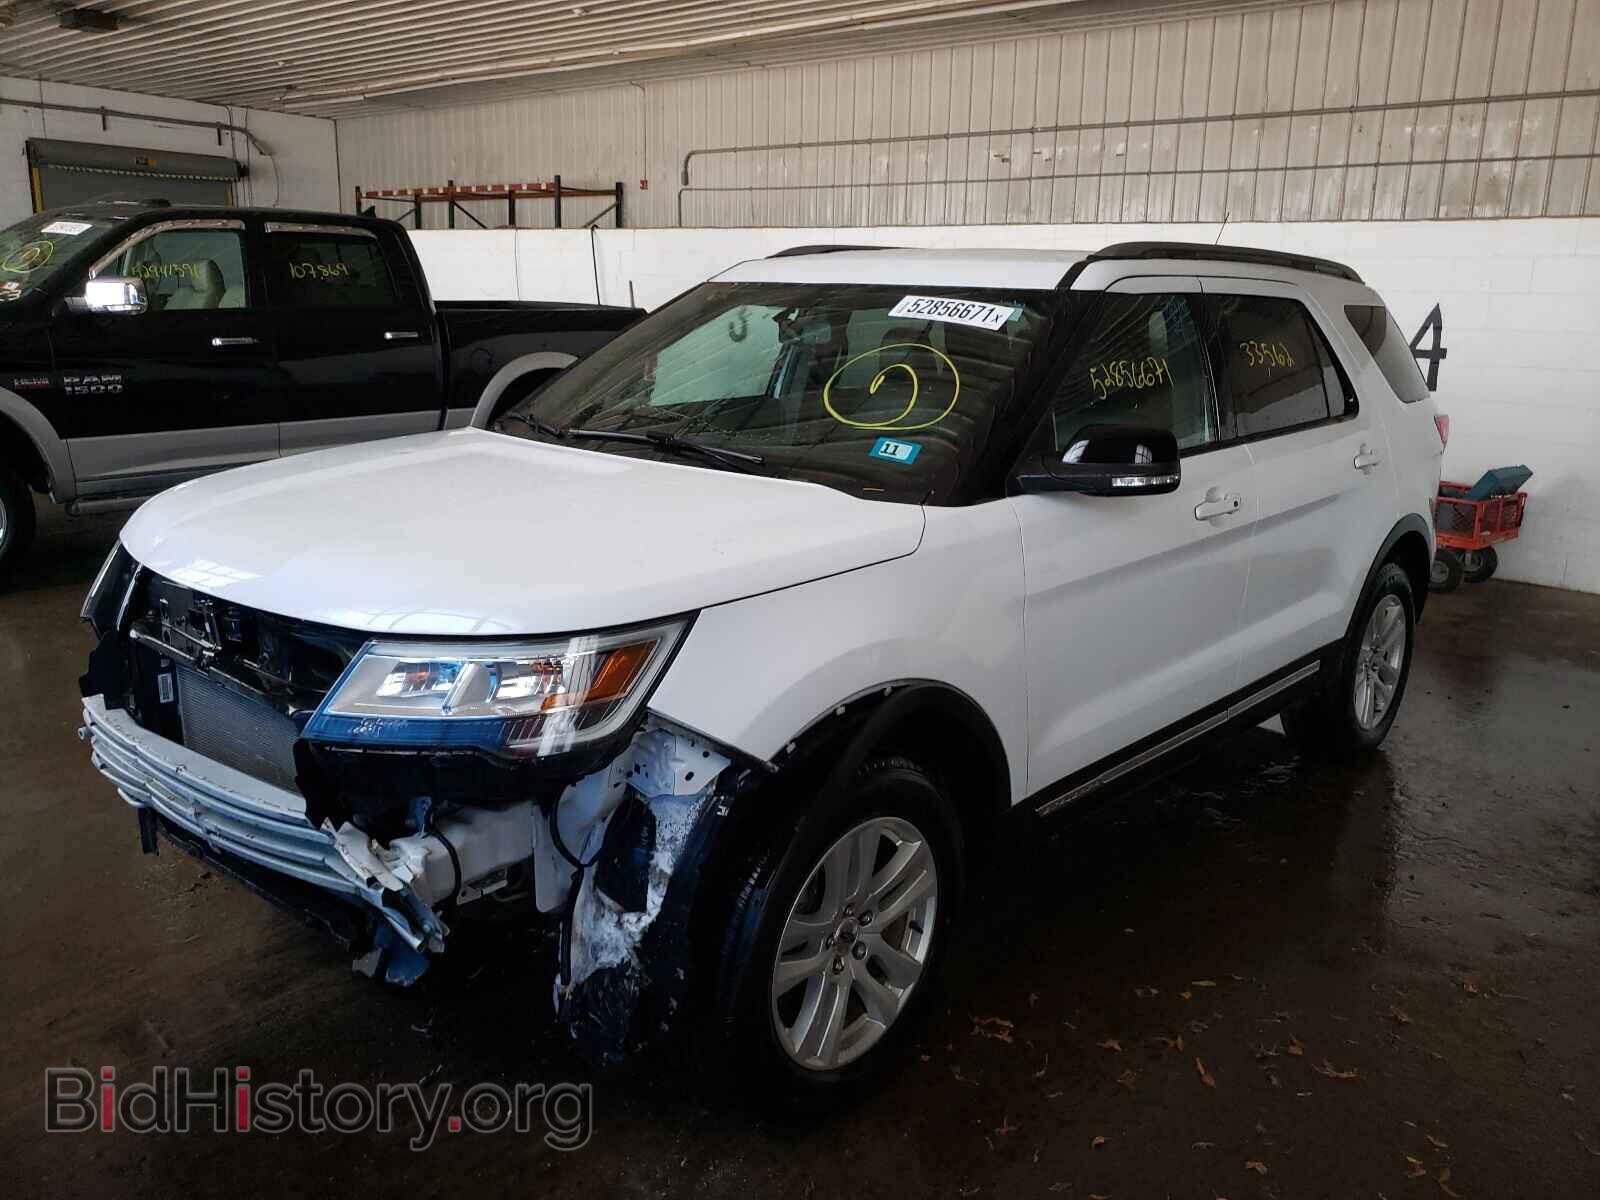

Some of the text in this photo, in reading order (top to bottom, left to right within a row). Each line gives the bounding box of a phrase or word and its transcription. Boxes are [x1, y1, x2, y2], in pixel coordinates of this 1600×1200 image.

[907, 298, 997, 323] 52856671
[1409, 302, 1447, 392] 4
[63, 375, 122, 385] RAM
[64, 384, 123, 395] 1500
[880, 443, 899, 456] 11
